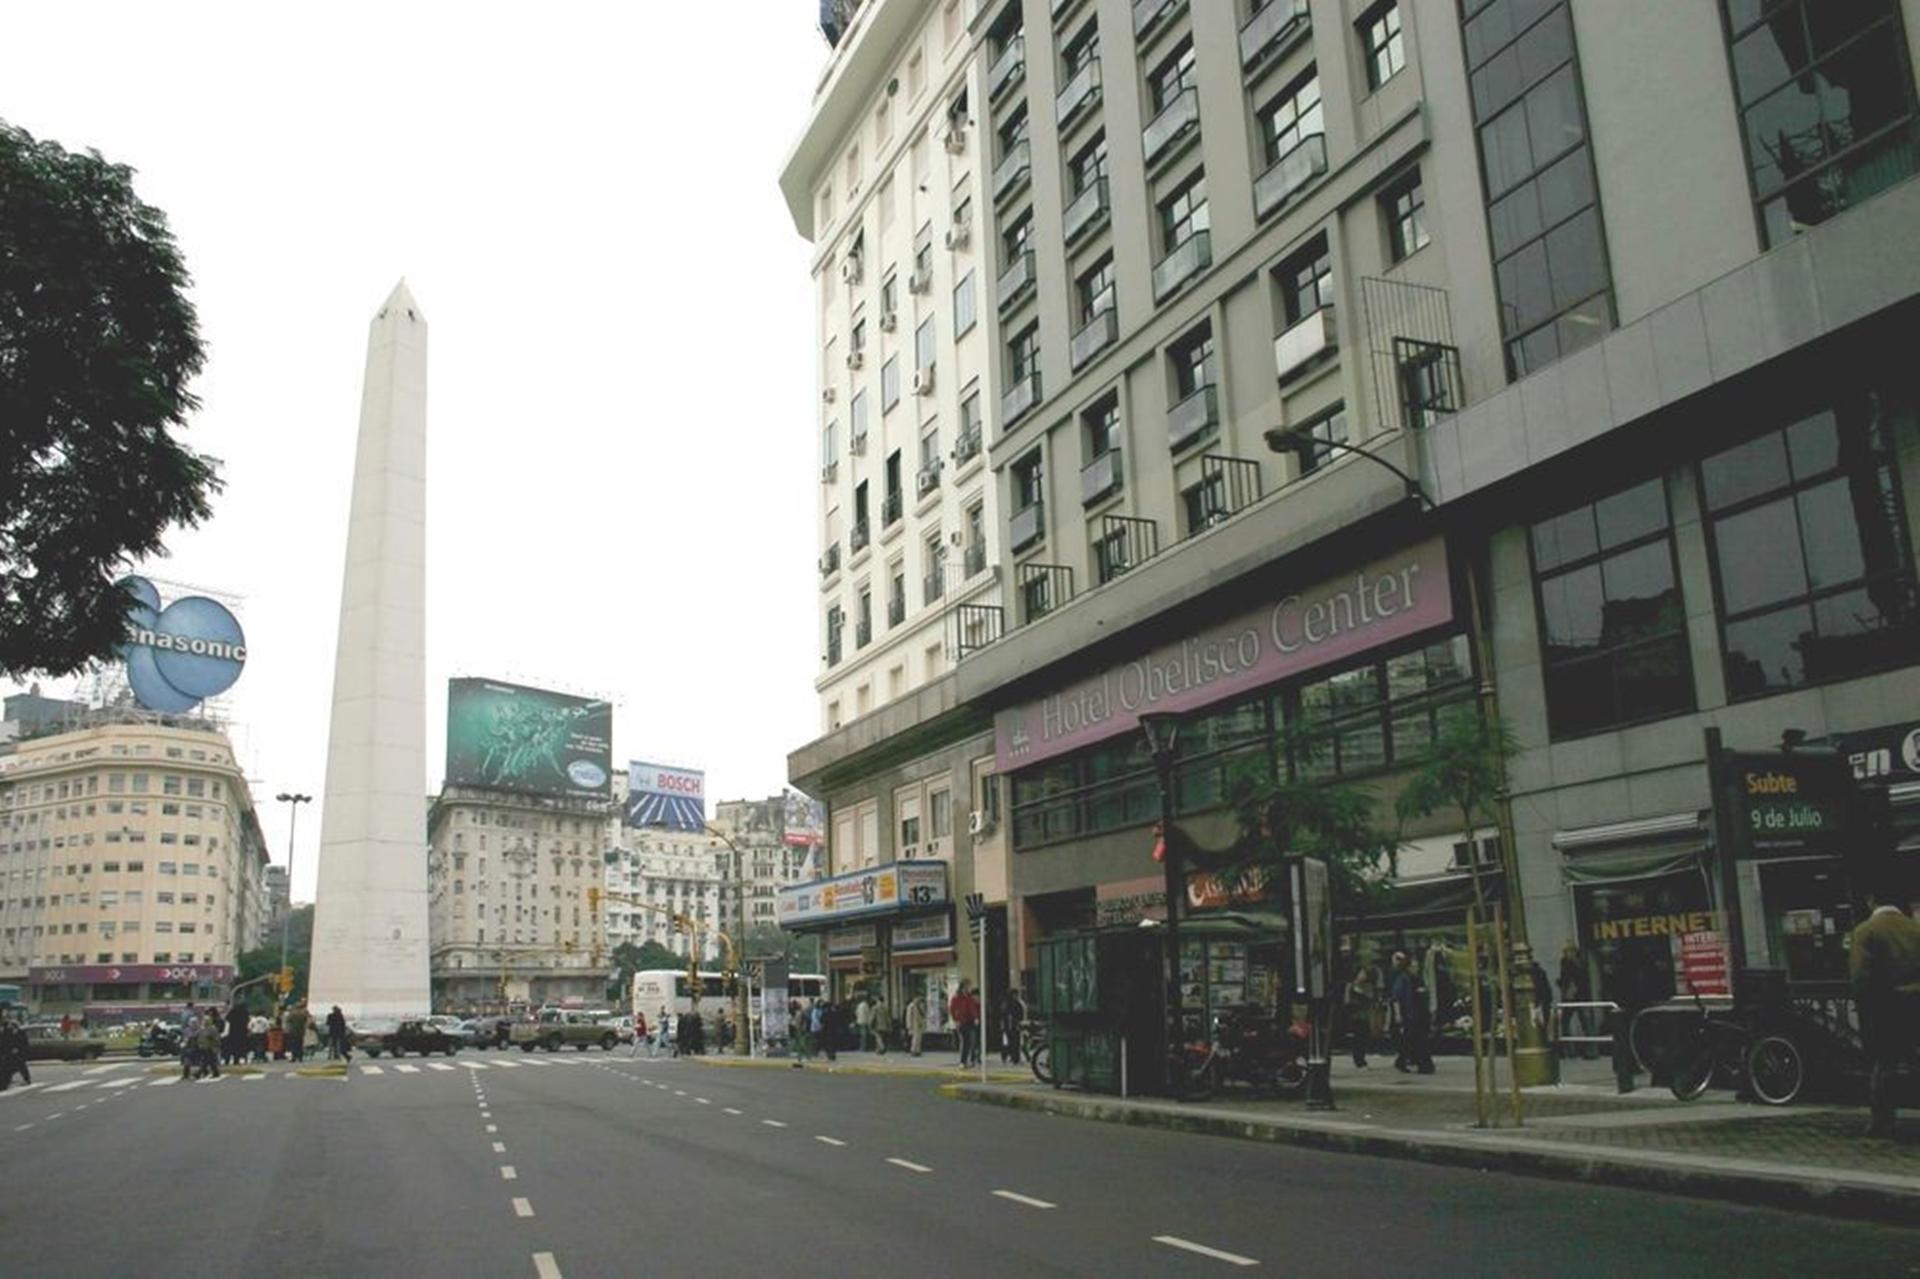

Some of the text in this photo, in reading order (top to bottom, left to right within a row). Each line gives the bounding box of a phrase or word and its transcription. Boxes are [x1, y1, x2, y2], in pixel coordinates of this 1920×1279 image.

[125, 624, 247, 661] anasonic
[1042, 563, 1419, 740] Hotel Obelisco Center
[656, 772, 700, 794] BOSCH
[1746, 771, 1797, 794] Subte
[1751, 805, 1823, 829] 9 de Julio
[1593, 911, 1722, 940] INTERNET
[171, 967, 197, 979] OCA
